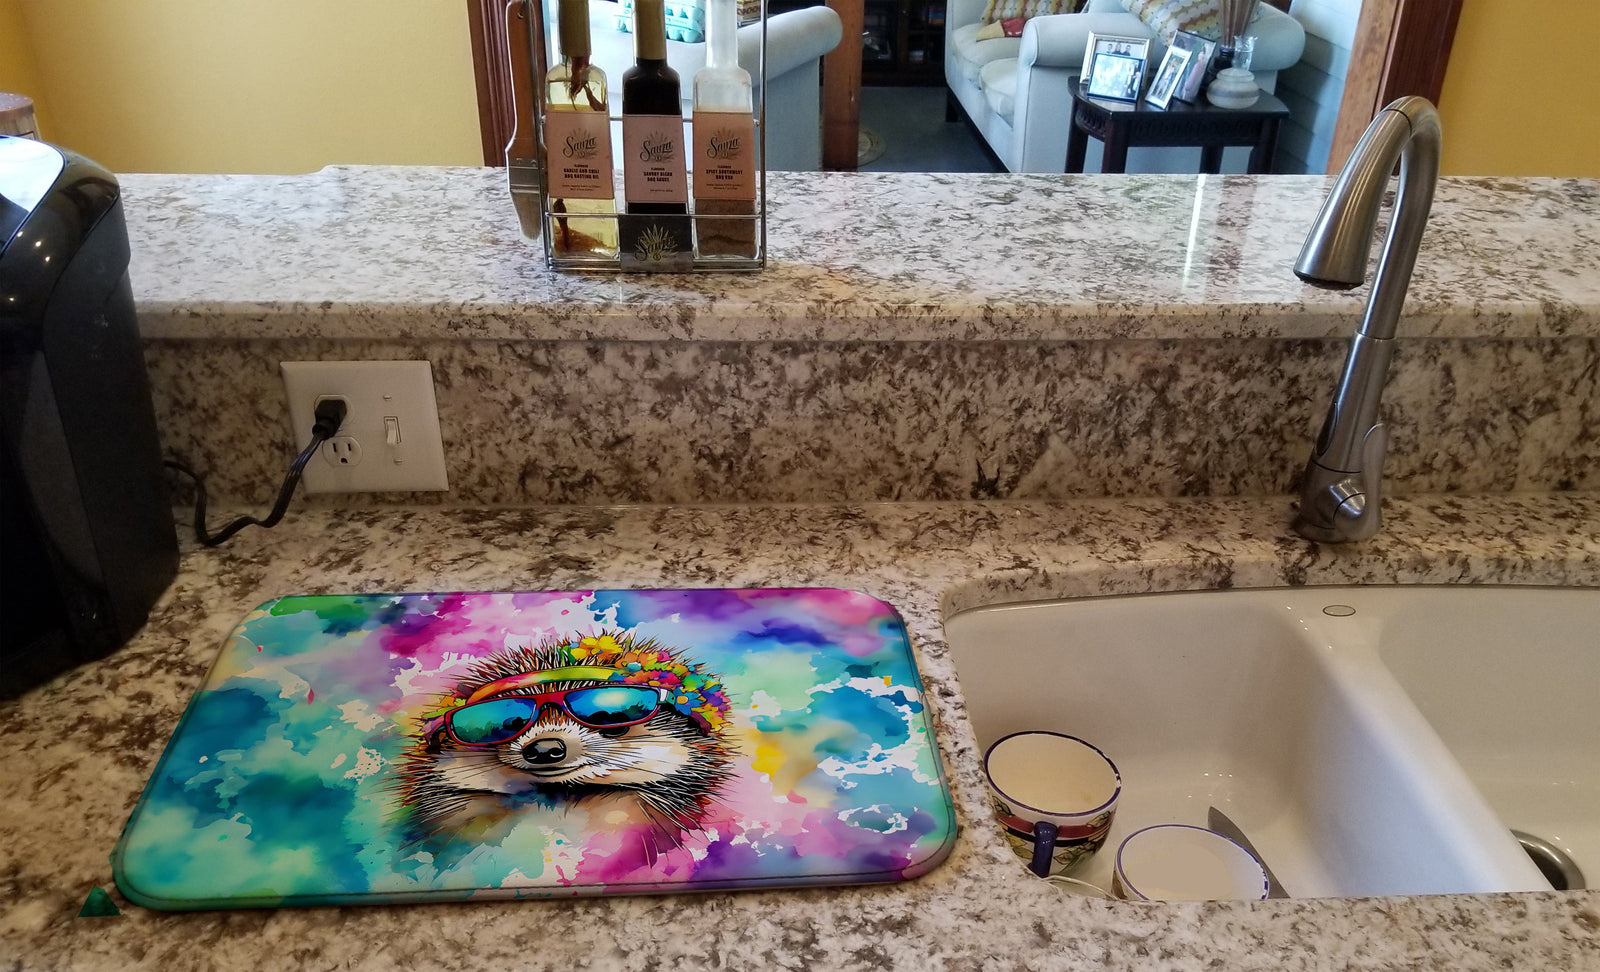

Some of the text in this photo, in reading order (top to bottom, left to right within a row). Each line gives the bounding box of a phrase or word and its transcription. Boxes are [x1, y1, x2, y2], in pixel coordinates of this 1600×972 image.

[562, 136, 597, 158] Sauza
[639, 140, 674, 162] Sauza
[706, 136, 740, 159] Sauza
